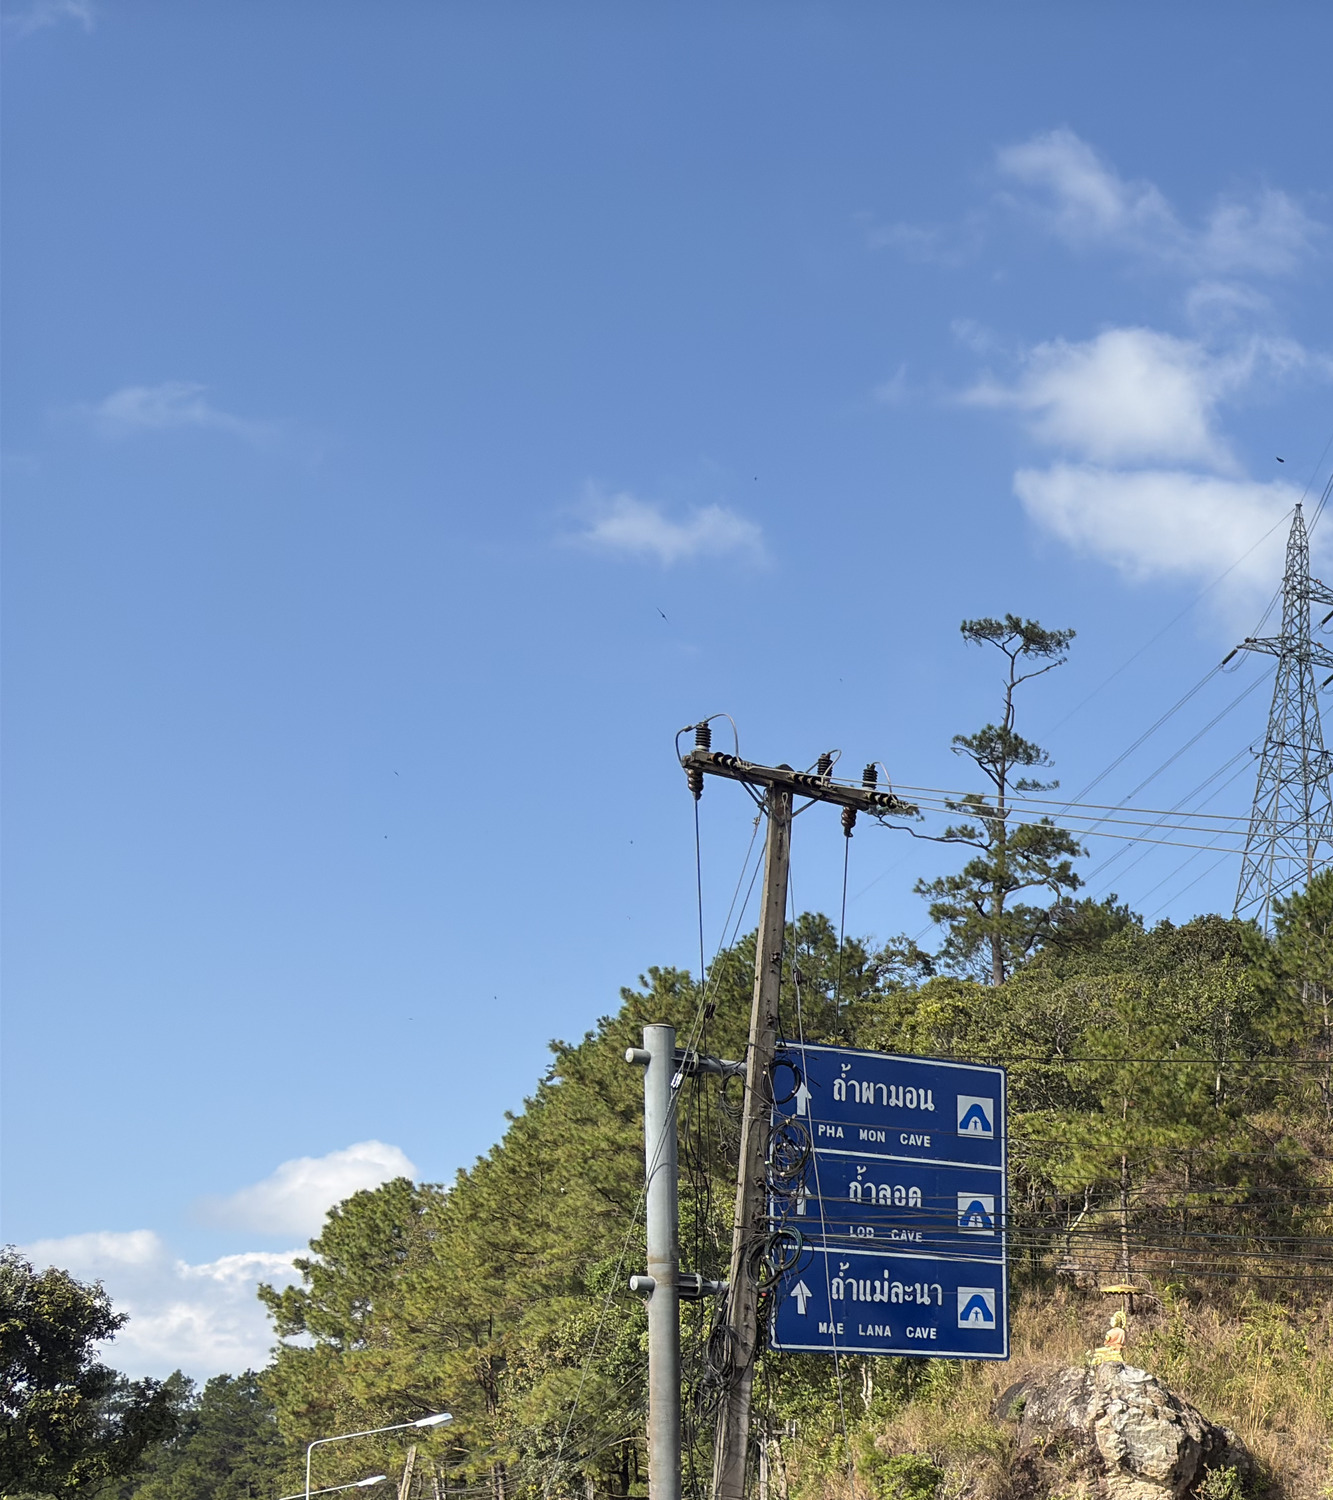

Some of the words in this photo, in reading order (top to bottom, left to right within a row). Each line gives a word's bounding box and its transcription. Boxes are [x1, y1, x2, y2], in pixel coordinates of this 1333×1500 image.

[833, 1063, 935, 1111] ถ้ำผามอน
[818, 1124, 844, 1139] PHA
[859, 1128, 886, 1143] MON
[900, 1133, 932, 1148] CAVE
[849, 1225, 875, 1239] LOD
[891, 1229, 923, 1243] CAVE
[831, 1262, 943, 1306] ถ้ำแม่ละนา
[818, 1322, 844, 1335] MAE
[858, 1323, 892, 1337] LANA
[906, 1326, 937, 1340] CAVE
